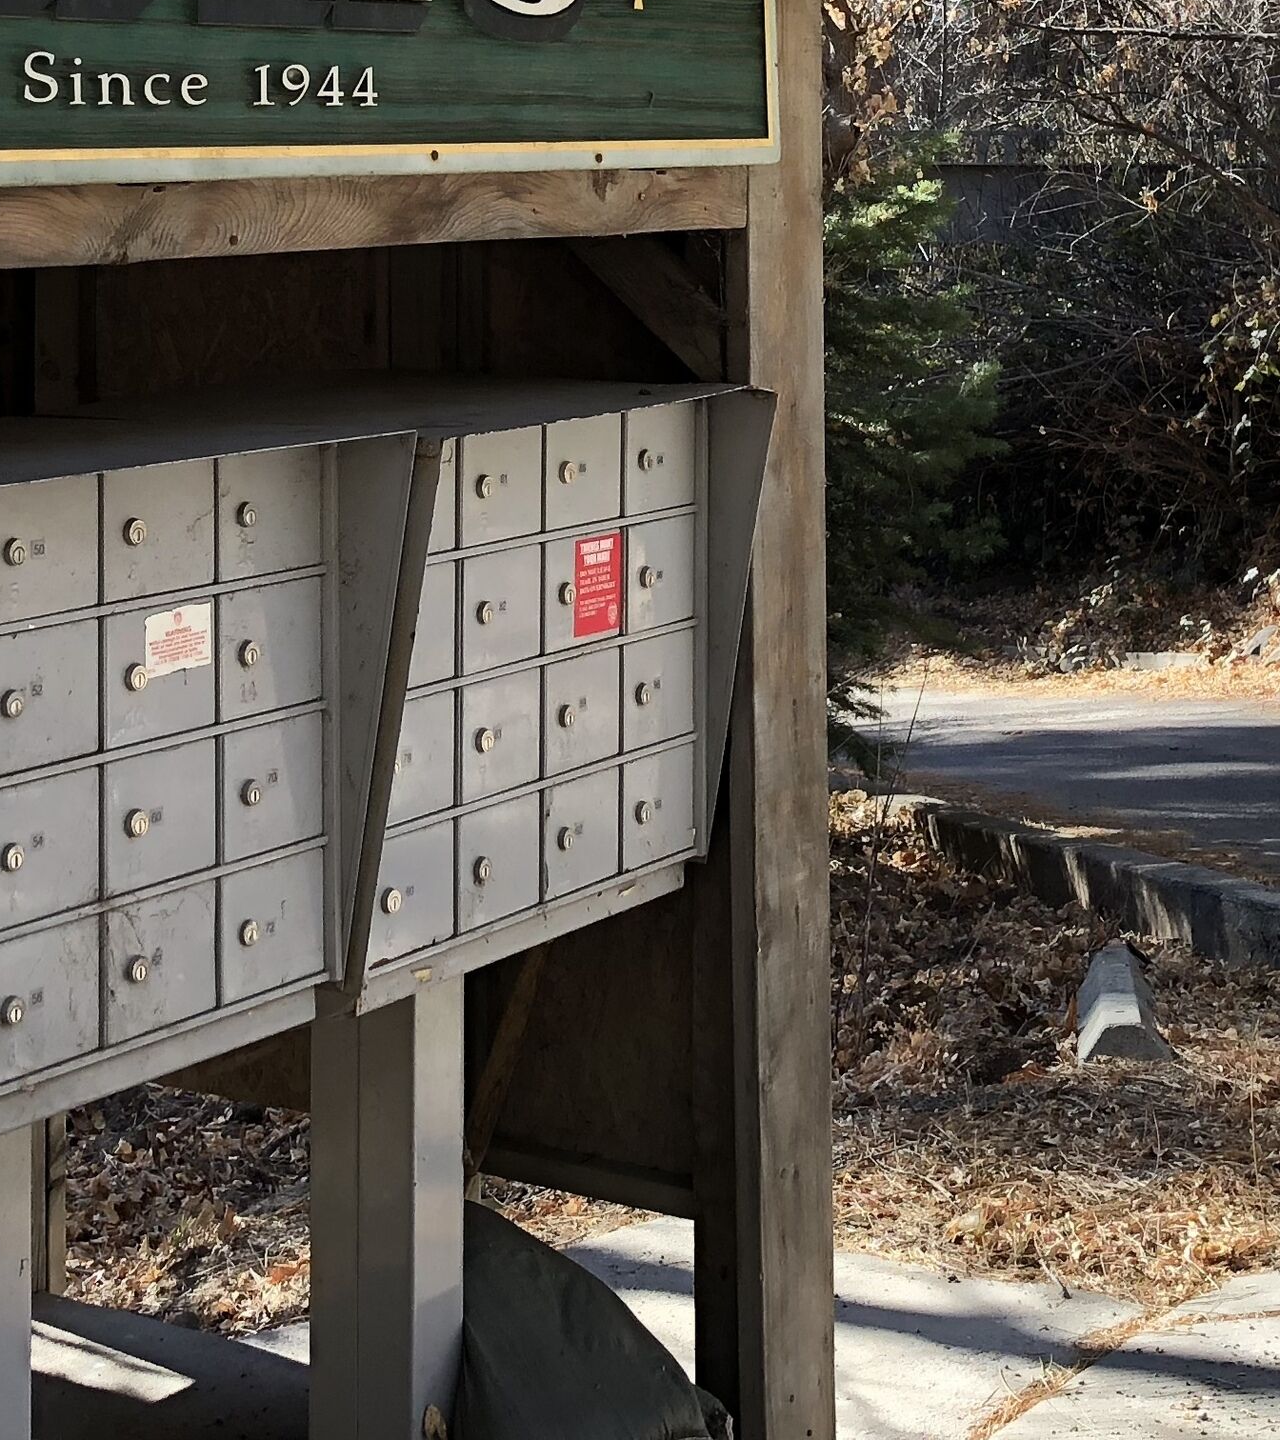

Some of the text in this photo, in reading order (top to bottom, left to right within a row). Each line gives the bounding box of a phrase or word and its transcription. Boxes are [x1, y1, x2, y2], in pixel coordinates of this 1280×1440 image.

[23, 51, 378, 107] Since 1944
[33, 544, 45, 557] 50
[31, 683, 44, 698] 52
